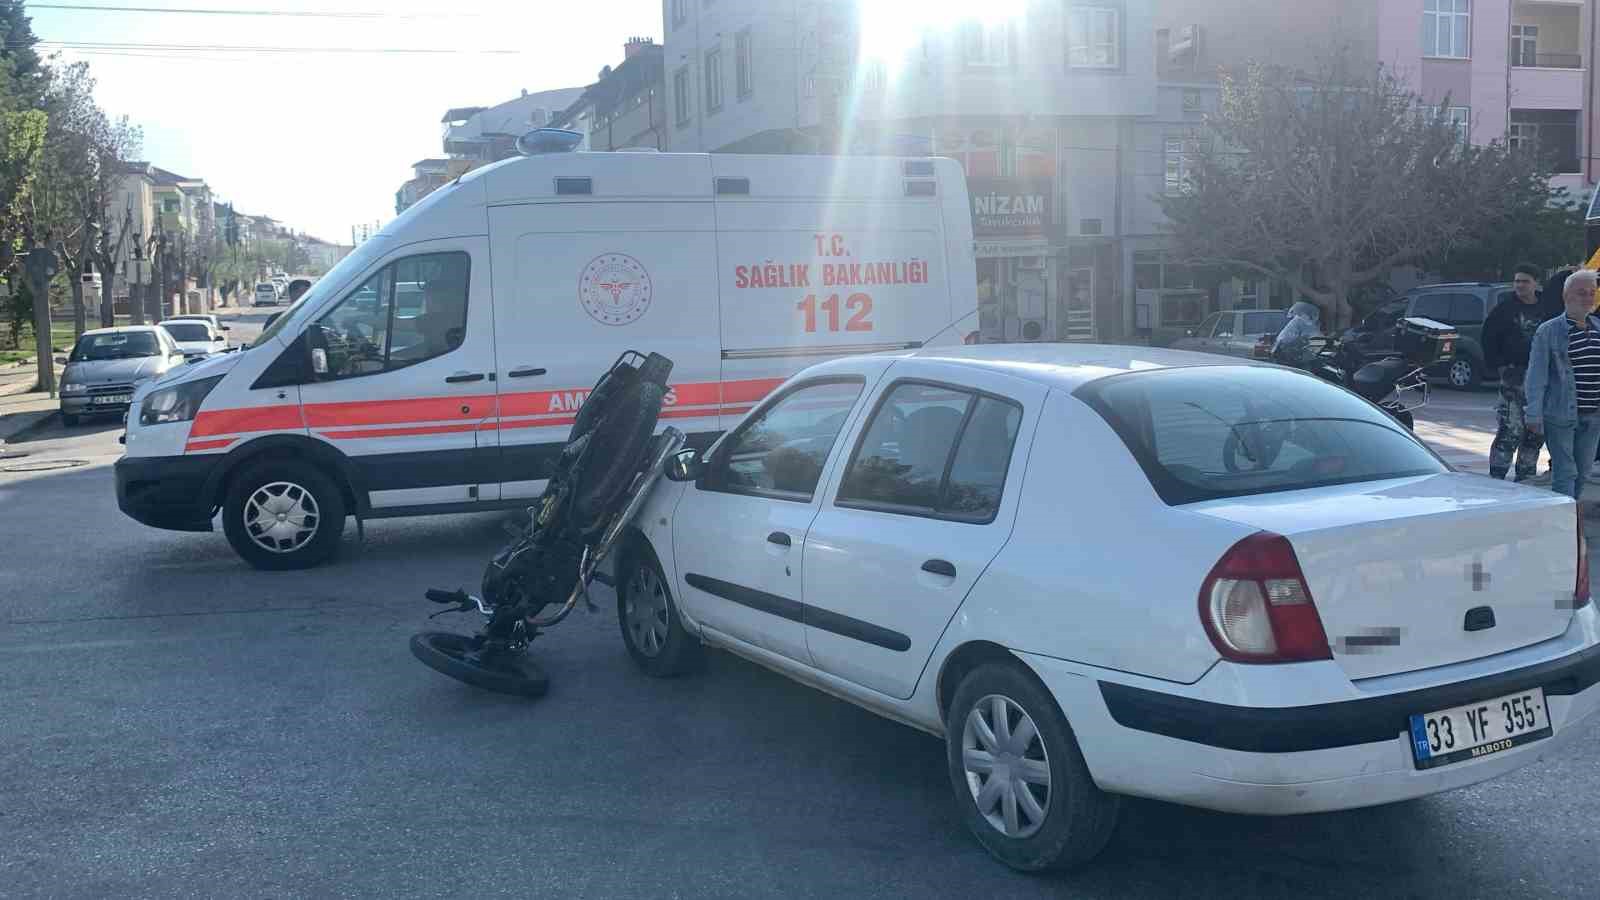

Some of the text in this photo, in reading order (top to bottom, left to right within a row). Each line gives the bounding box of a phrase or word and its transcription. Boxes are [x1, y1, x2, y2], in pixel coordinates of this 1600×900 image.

[975, 192, 1043, 214] NİZAM
[815, 234, 850, 257] T.C.
[736, 257, 928, 289] SAĞLIK BAKANLIĞI
[797, 292, 873, 333] 112
[1417, 695, 1535, 752] TR 33 YF 355
